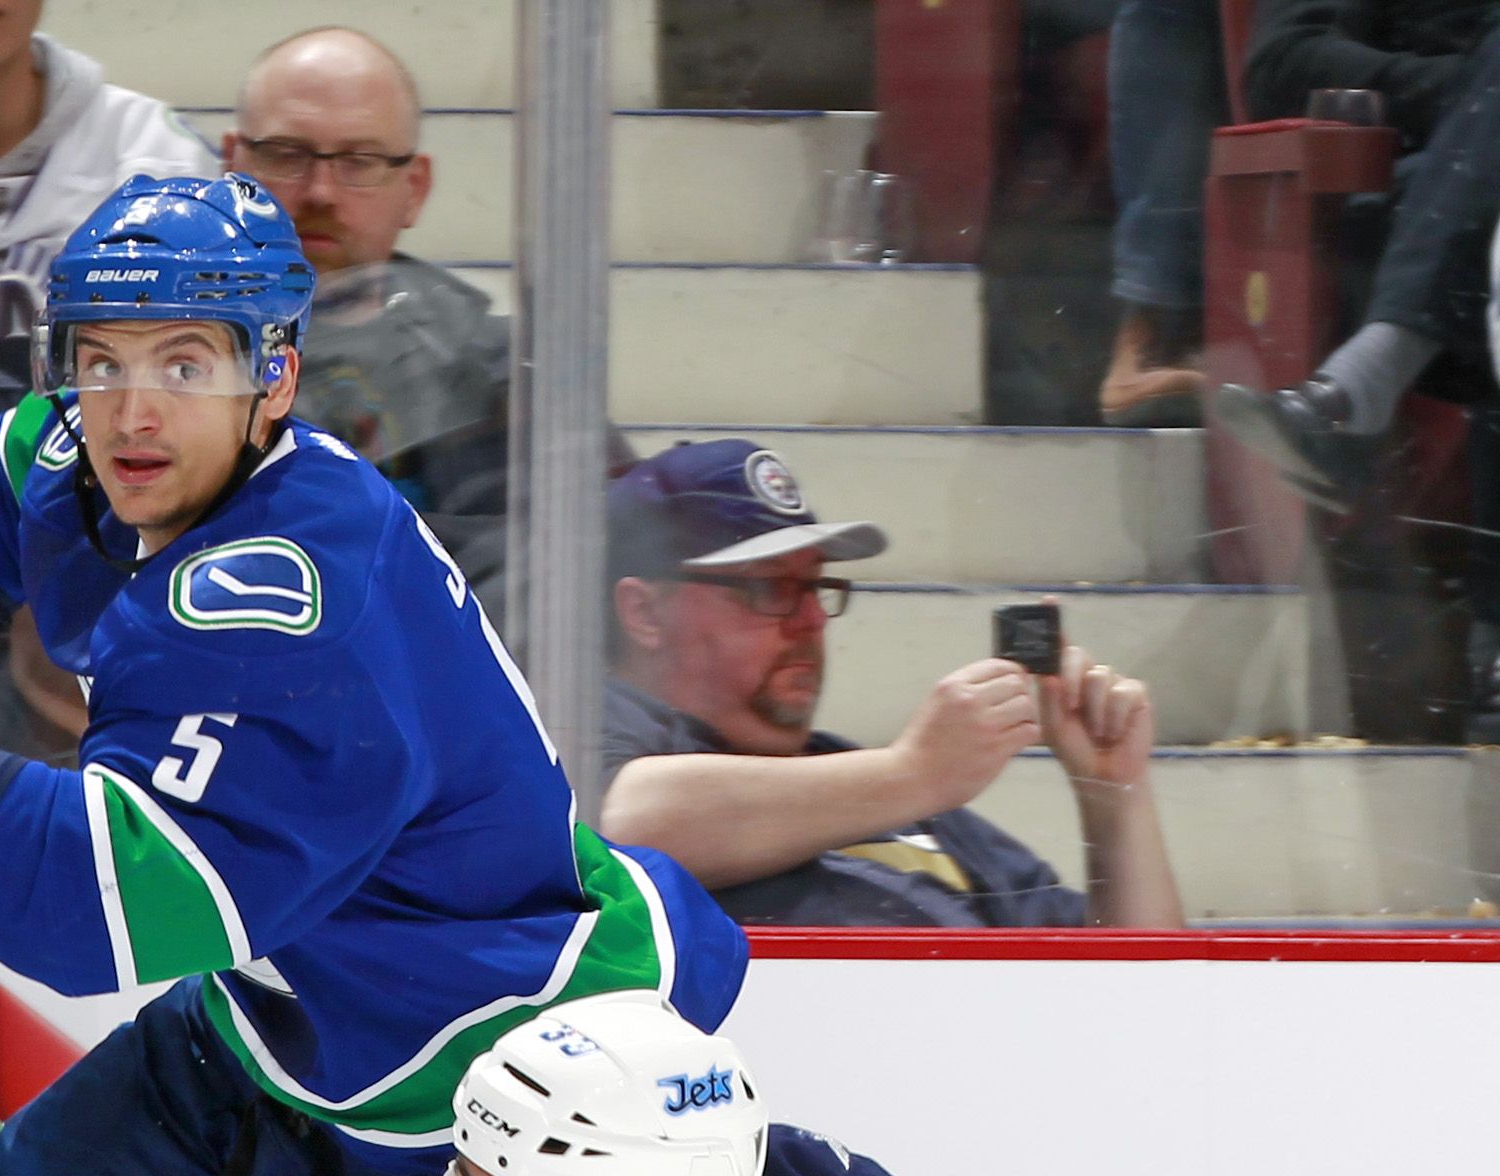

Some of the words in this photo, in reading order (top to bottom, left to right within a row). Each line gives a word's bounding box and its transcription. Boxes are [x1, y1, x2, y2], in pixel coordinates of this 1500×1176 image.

[84, 269, 160, 284] BAUER
[151, 712, 238, 804] 5
[658, 1066, 734, 1117] Jets
[467, 1098, 521, 1138] CCM
